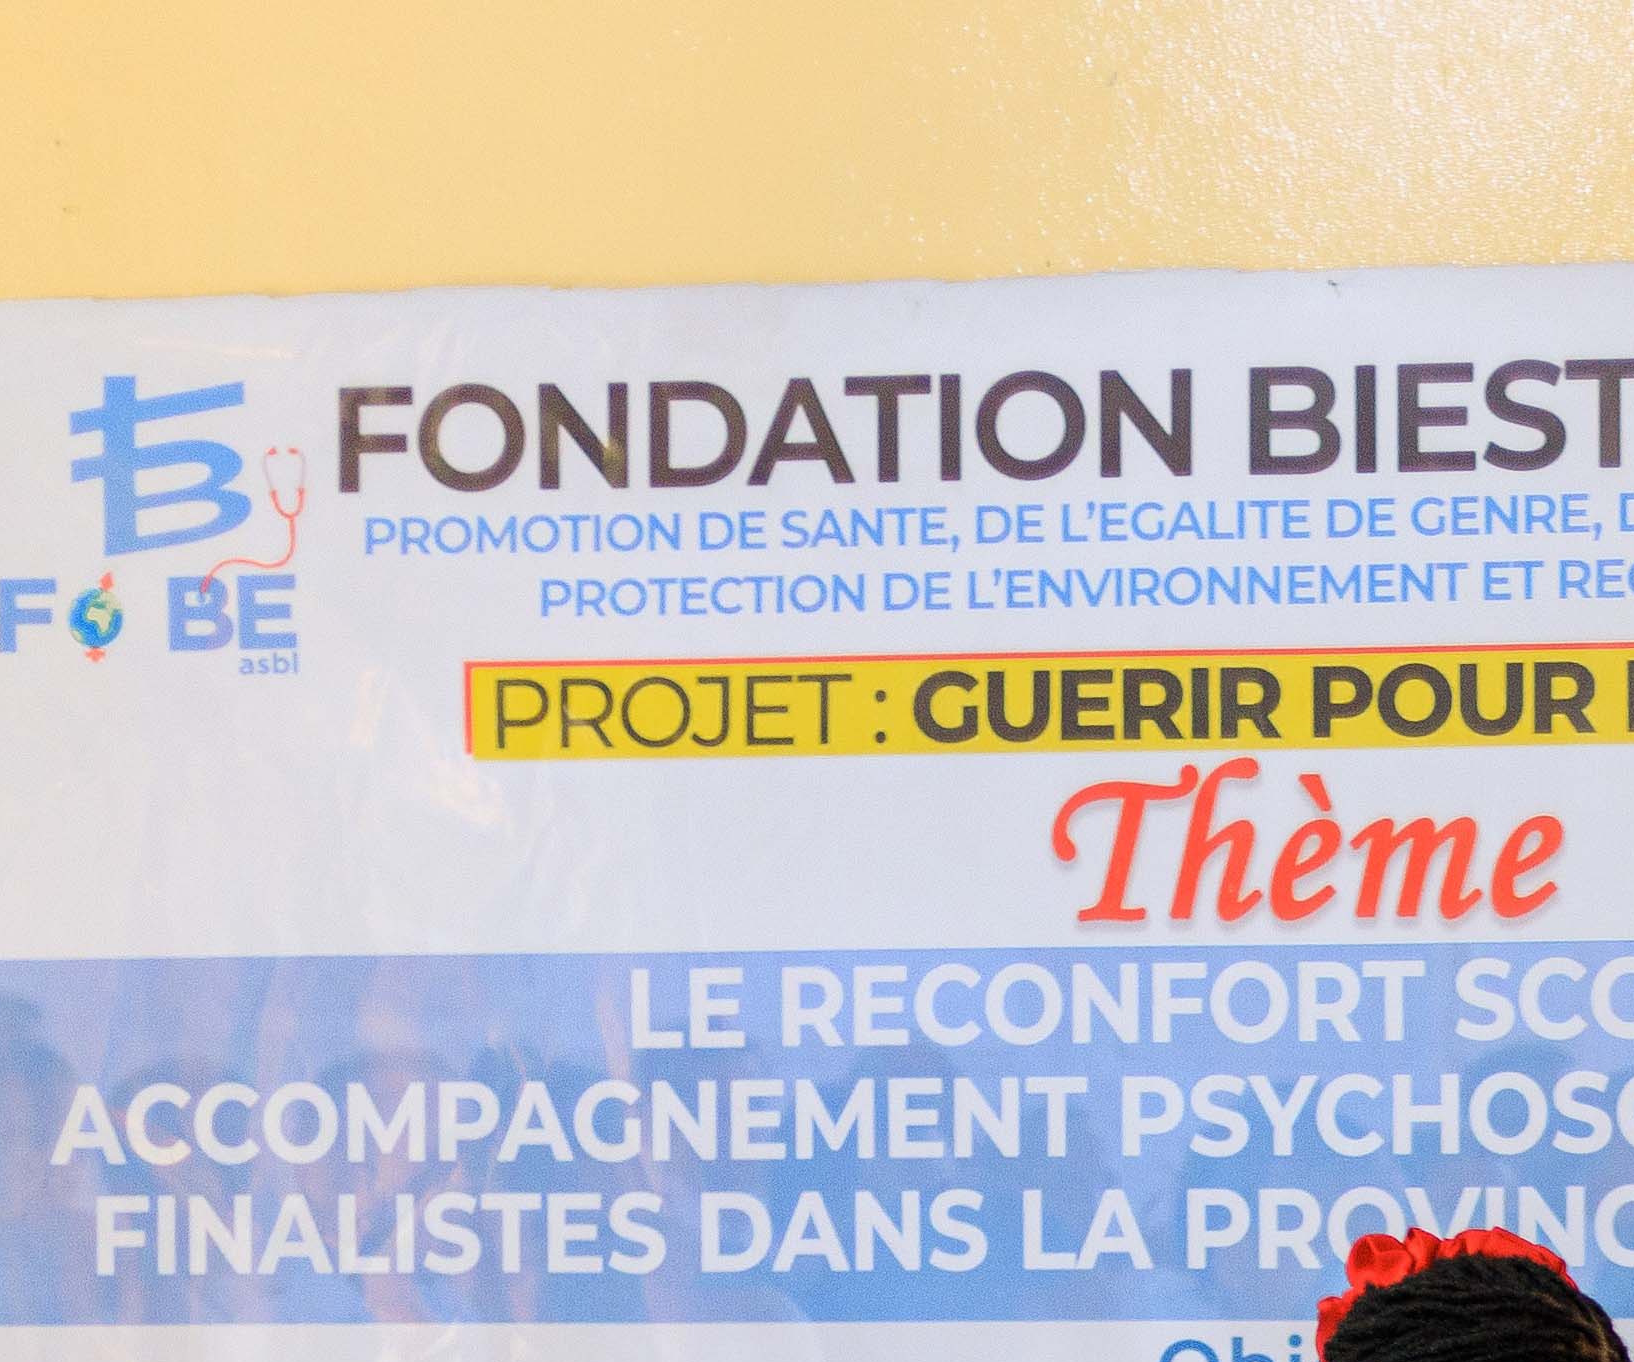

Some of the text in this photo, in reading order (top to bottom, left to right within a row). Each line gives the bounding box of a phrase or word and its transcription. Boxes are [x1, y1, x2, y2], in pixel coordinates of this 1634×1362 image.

[338, 370, 1193, 493] FONDATION
[366, 512, 681, 555] PROMOTION
[699, 509, 766, 552] DE
[782, 506, 960, 553] SANTE,
[975, 503, 1045, 544] DE
[1327, 497, 1395, 539] DE
[1411, 491, 1603, 541] GENRE,
[540, 573, 867, 618] PROTECTION
[882, 570, 952, 612] DE
[1481, 559, 1546, 601] ET
[239, 652, 299, 676] asbl
[496, 674, 852, 748] PROJET
[912, 666, 1282, 743] GUERIR
[1312, 660, 1596, 738] POUR
[1052, 757, 1564, 922] Thème
[630, 967, 745, 1049] LE
[781, 961, 1426, 1047] RECONFORT
[51, 1075, 1086, 1166] ACCOMPAGNEMENT
[95, 1191, 667, 1277] FINALISTES
[699, 1189, 990, 1273] DANS
[1021, 1188, 1153, 1271] LA
